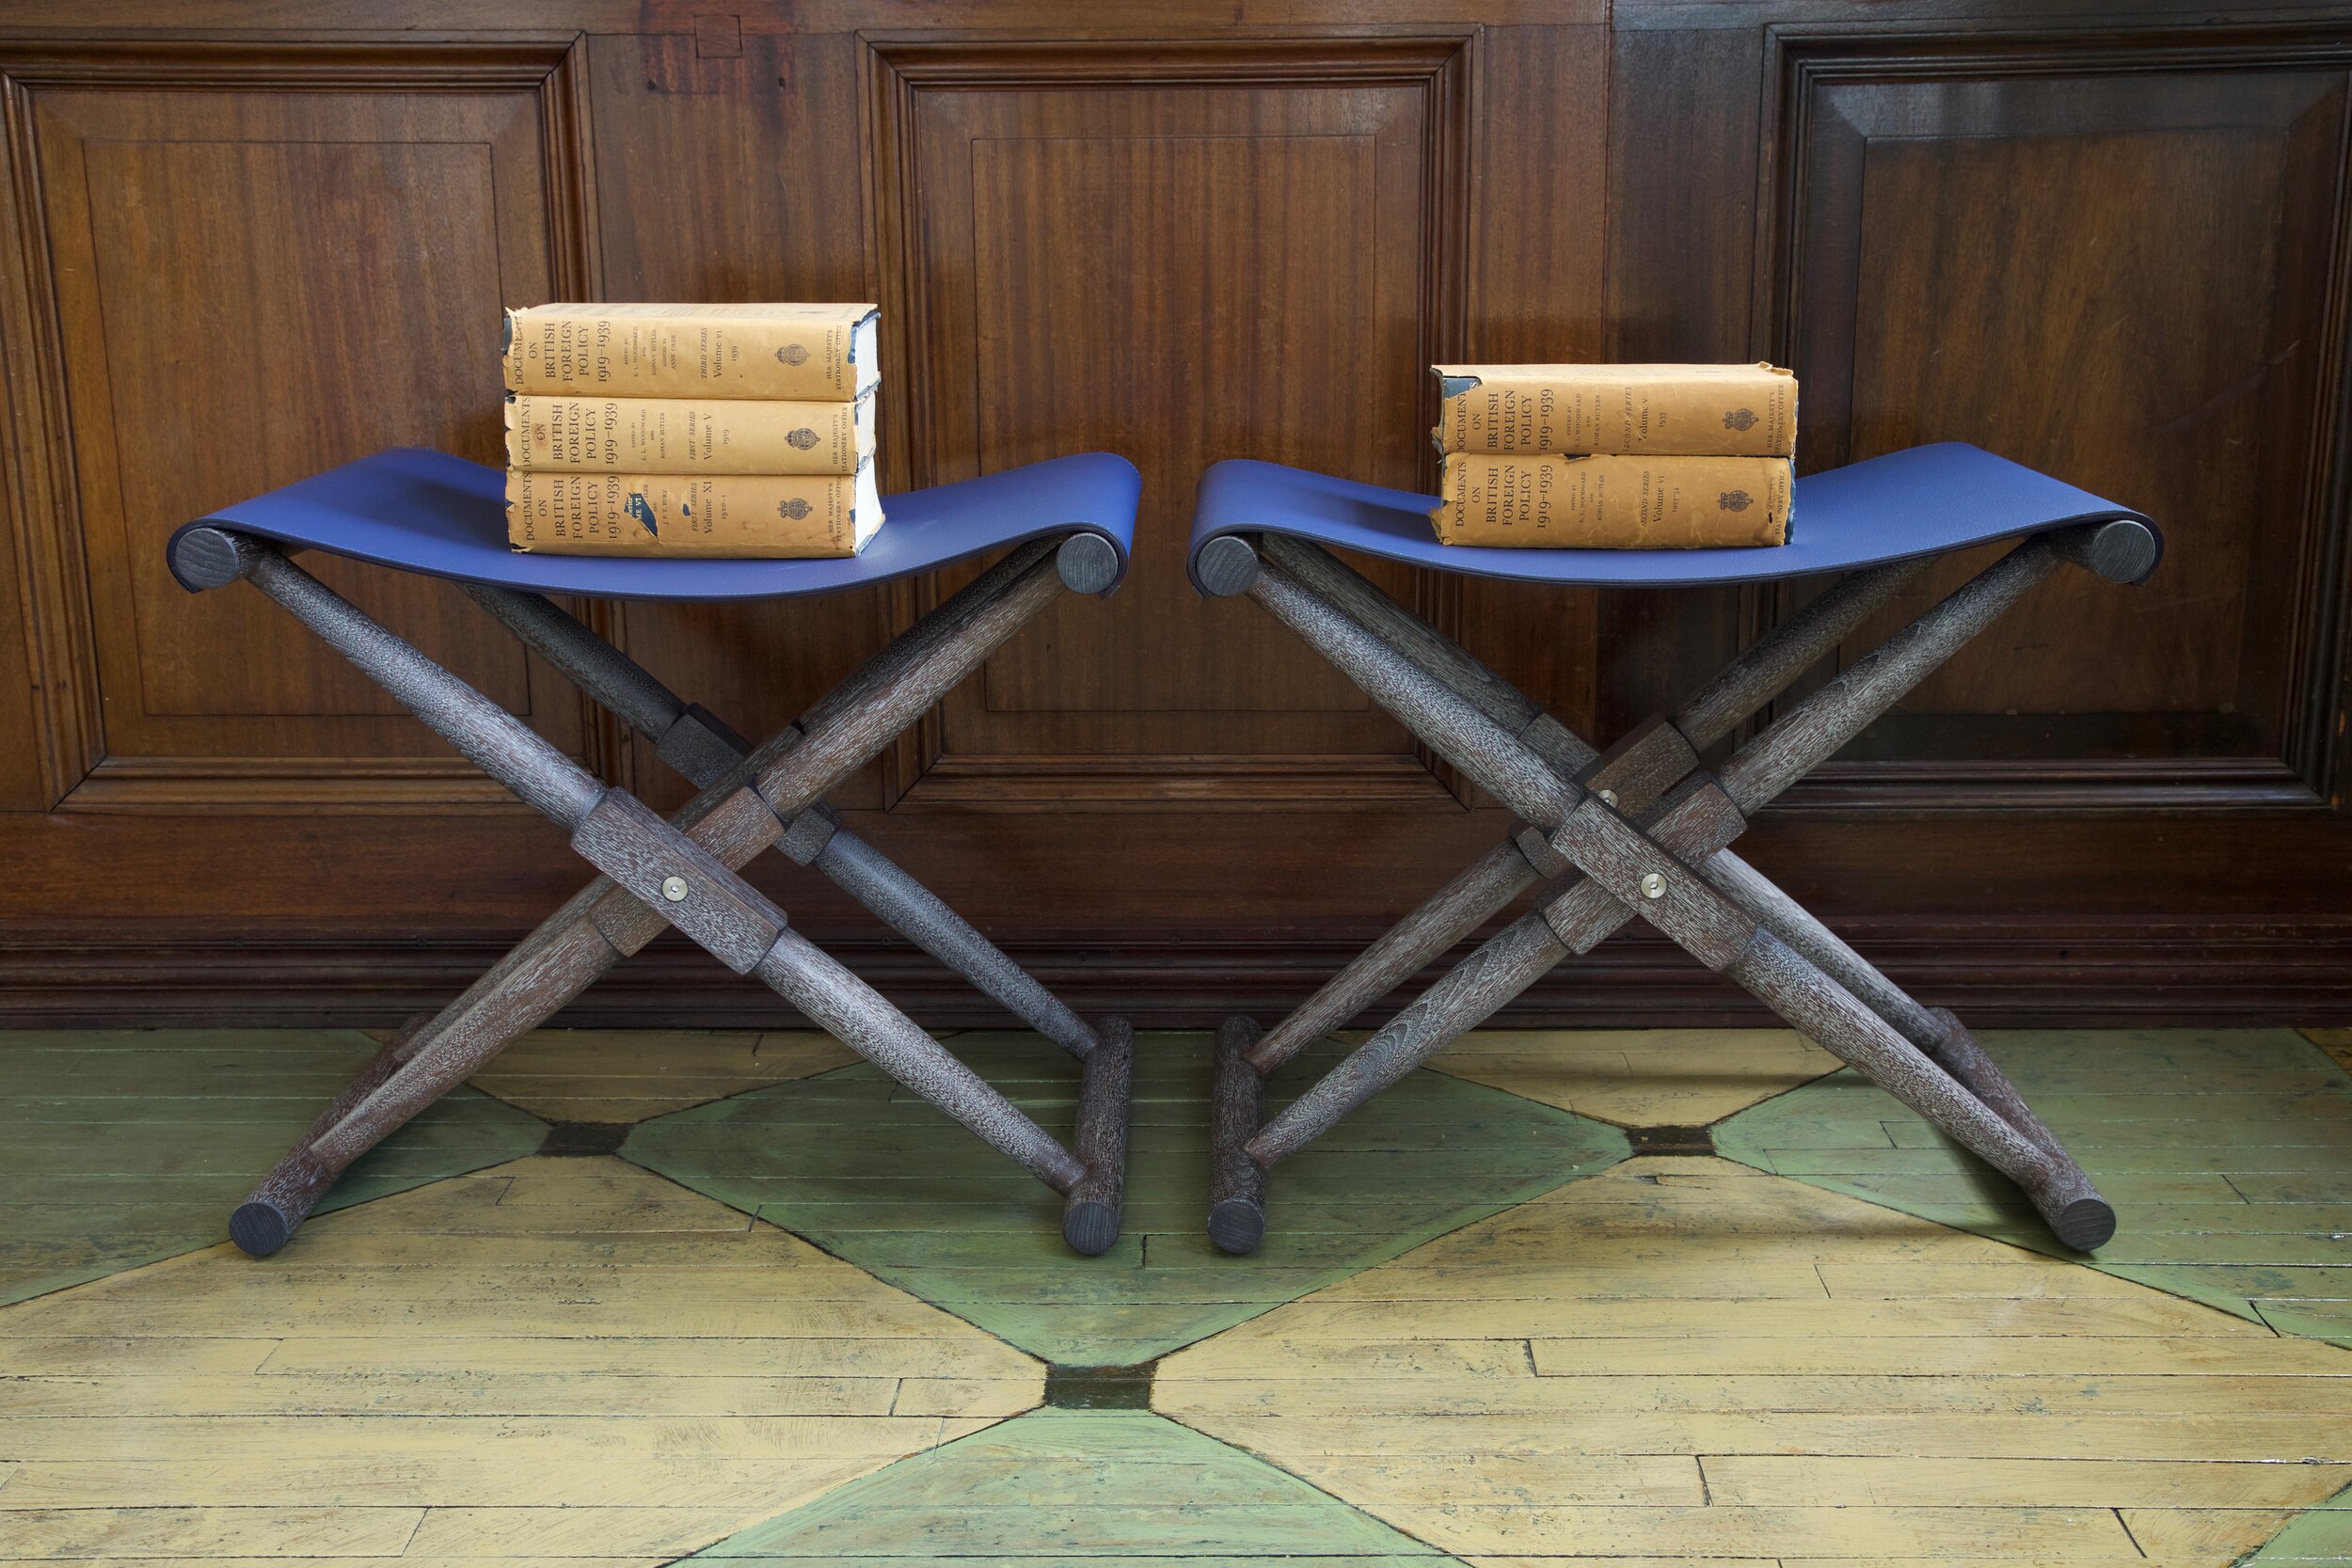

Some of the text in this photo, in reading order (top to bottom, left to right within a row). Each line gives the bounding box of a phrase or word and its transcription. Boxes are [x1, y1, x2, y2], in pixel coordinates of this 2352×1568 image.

[529, 342, 537, 359] ON
[545, 323, 556, 378] BRITISH
[562, 321, 573, 382] FOREIGN
[578, 325, 589, 376] POLICY
[713, 342, 723, 379] Volume
[521, 397, 532, 467] DOCUMENTS
[536, 423, 546, 441] ON
[552, 404, 564, 460] BRITISH
[569, 402, 580, 464] FOREIGN
[585, 407, 596, 460] POLICY
[704, 424, 712, 460] Volume
[1456, 393, 1467, 452] DOCUMENT
[1472, 413, 1482, 431] ON
[1487, 392, 1499, 449] BRITISH
[1503, 390, 1516, 451] FOREIGN
[1520, 395, 1532, 445] POLICY
[1639, 406, 1648, 442] Volume
[523, 472, 535, 542] DOCUMENTS
[538, 499, 547, 517] ON
[553, 480, 566, 537] BRITISH
[570, 475, 583, 540] FOREIGN
[587, 481, 599, 533] POLICY
[703, 481, 713, 534] Volume XI
[1455, 461, 1467, 527] DOCUMENTS
[1471, 486, 1481, 503] ON
[1486, 467, 1499, 524] BRITISH
[1502, 465, 1515, 526] FOREIGN
[1518, 470, 1532, 522] POLICY
[1653, 487, 1664, 522] Volume
